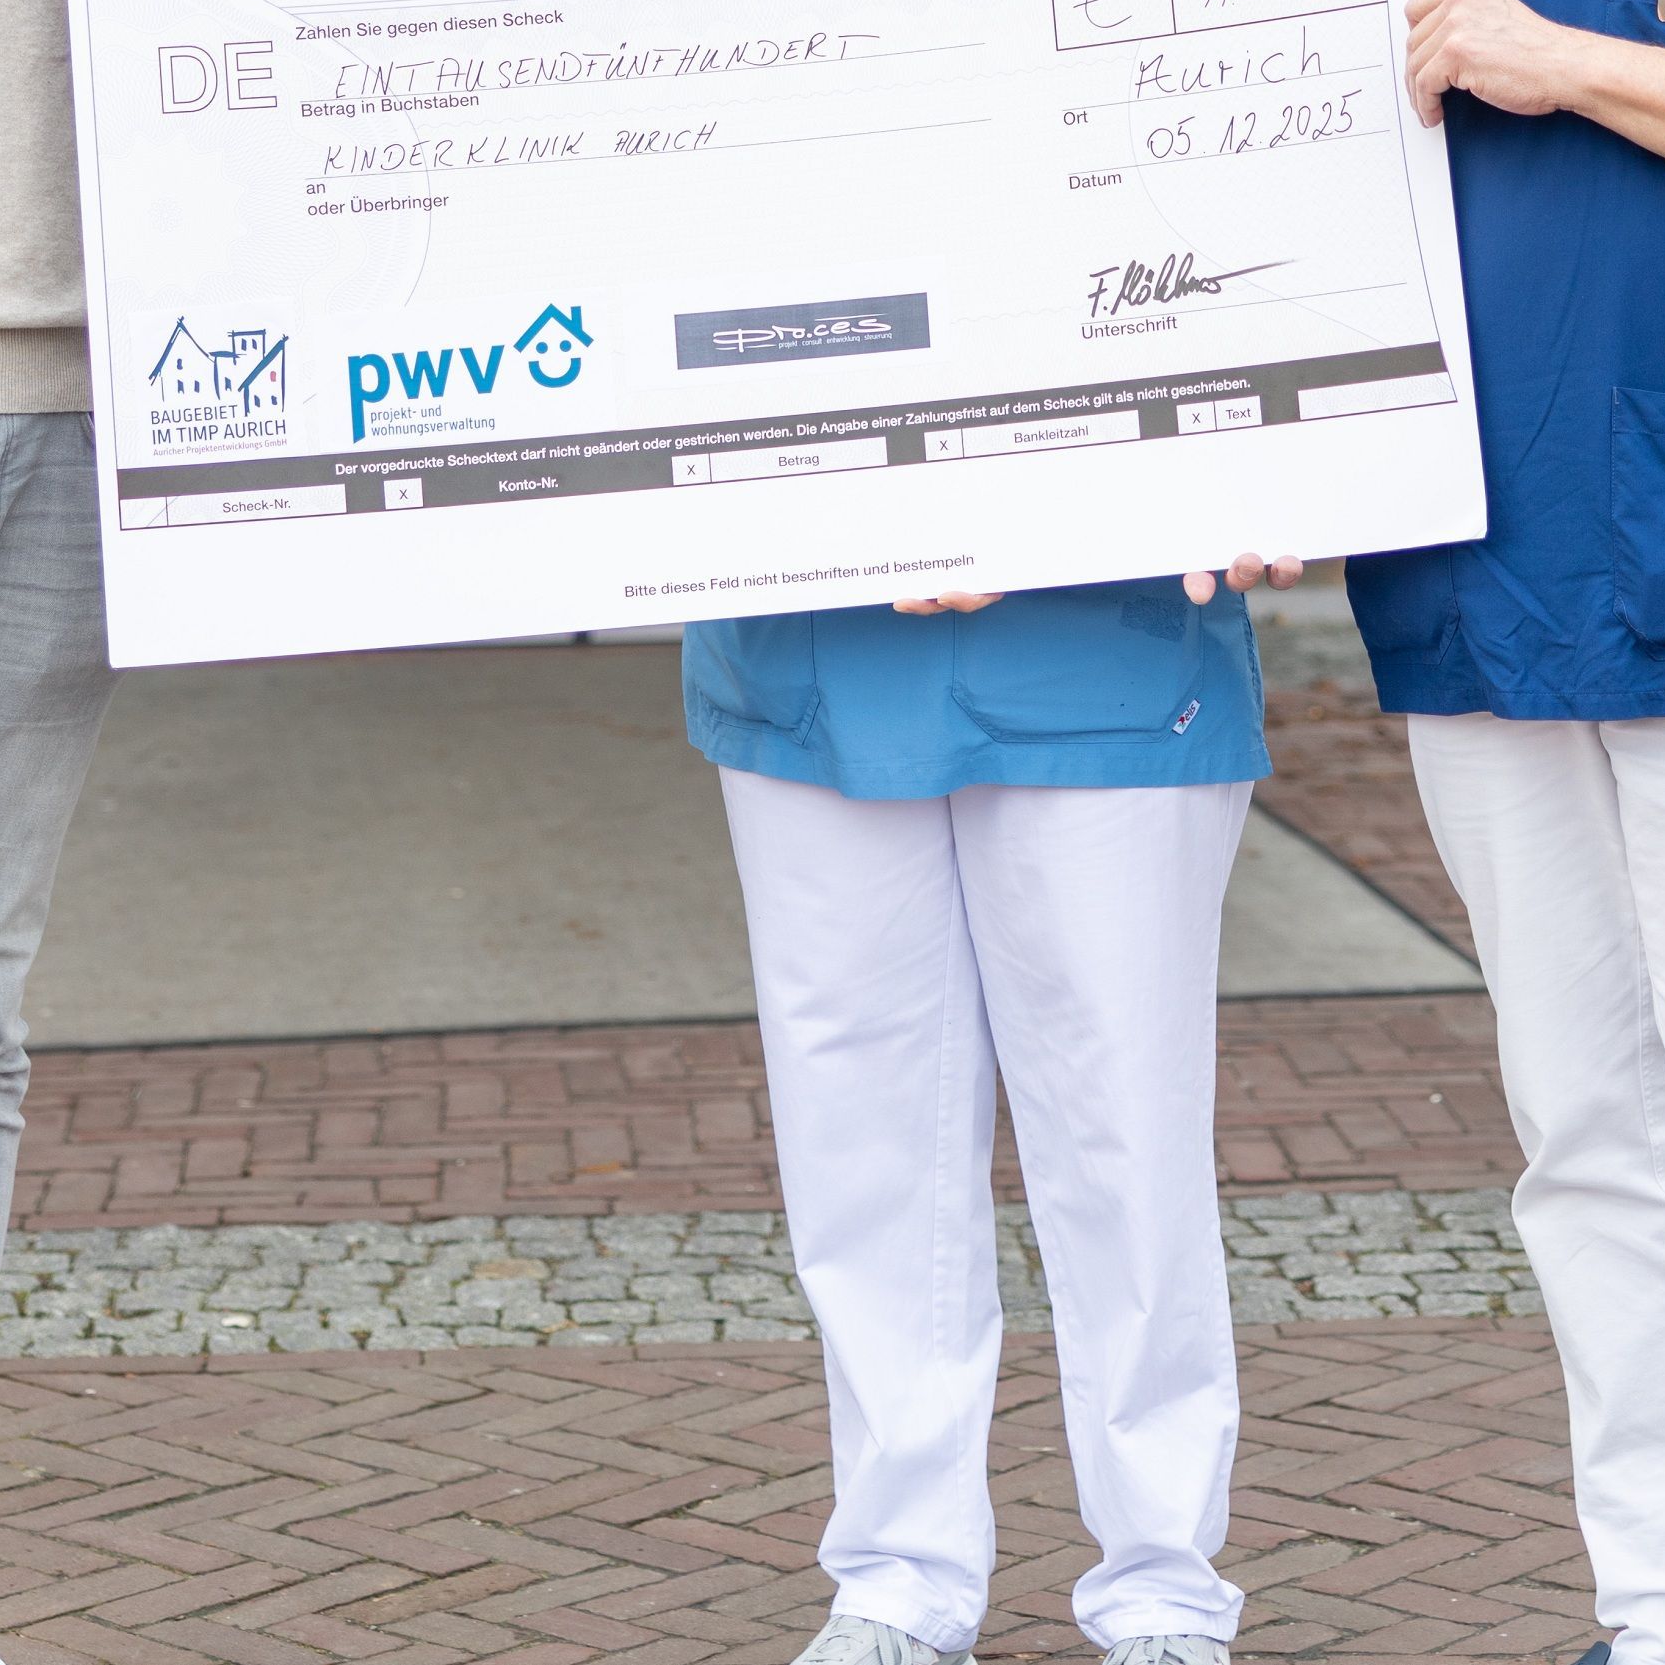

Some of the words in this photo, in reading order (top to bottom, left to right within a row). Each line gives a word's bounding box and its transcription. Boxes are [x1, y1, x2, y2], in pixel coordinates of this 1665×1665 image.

[295, 24, 351, 41] Zahlen
[356, 22, 382, 38] Sie
[387, 20, 438, 38] gegen
[443, 15, 498, 32] diesen
[502, 10, 564, 27] Scheck
[1135, 25, 1322, 99] Aurich
[158, 41, 277, 114] DE
[301, 99, 356, 118] Betrag
[361, 100, 376, 114] in
[380, 94, 480, 113] Buchstaben
[1063, 110, 1088, 126] Ort
[614, 121, 717, 156] AURICH
[305, 181, 327, 196] an
[1068, 172, 1122, 190] Datum
[307, 201, 345, 217] oder
[350, 193, 449, 215] Überbringer
[1081, 316, 1178, 341] Unterschrift
[347, 344, 505, 444] pwv
[151, 405, 238, 425] BAUGEBIET
[370, 406, 417, 424] projekt-
[421, 404, 442, 418] und
[1225, 407, 1252, 420] Text
[152, 429, 172, 445] IM
[176, 425, 219, 443] TIMP
[224, 419, 286, 440] AURICH
[335, 462, 358, 476] Der
[360, 457, 445, 475] vorgedruckte
[447, 450, 518, 468] Schecktext
[520, 446, 547, 461] darf
[549, 444, 581, 459] nicht
[583, 439, 640, 457] geändert
[642, 436, 672, 450] oder
[675, 431, 740, 450] gestrichen
[743, 427, 794, 442] werden.
[796, 423, 818, 437] Die
[820, 419, 869, 437] Angabe
[871, 415, 903, 429] einer
[905, 407, 987, 427] Zahlungsfrist
[989, 403, 1010, 417] auf
[1012, 399, 1041, 414] dem
[1043, 394, 1091, 411] Scheck
[1093, 392, 1114, 409] gilt
[1115, 390, 1135, 403] als
[1136, 386, 1169, 401] nicht
[1170, 378, 1252, 400] geschrieben.
[371, 417, 496, 437] wohnungsverwaltung
[1013, 425, 1089, 444] Bankleitzahl
[153, 447, 185, 457] Auricher
[264, 438, 287, 448] GmbH
[778, 453, 820, 469] Betrag
[498, 476, 560, 493] Konto-Nr.
[222, 498, 291, 514] Scheck-Nr.
[624, 584, 657, 599] Bitte
[661, 580, 706, 595] dieses
[710, 576, 739, 591] Feld
[743, 572, 778, 587] nicht
[781, 565, 859, 584] beschriften
[863, 562, 889, 576] und
[893, 554, 975, 574] bestempeln
[1184, 703, 1197, 722] elis
